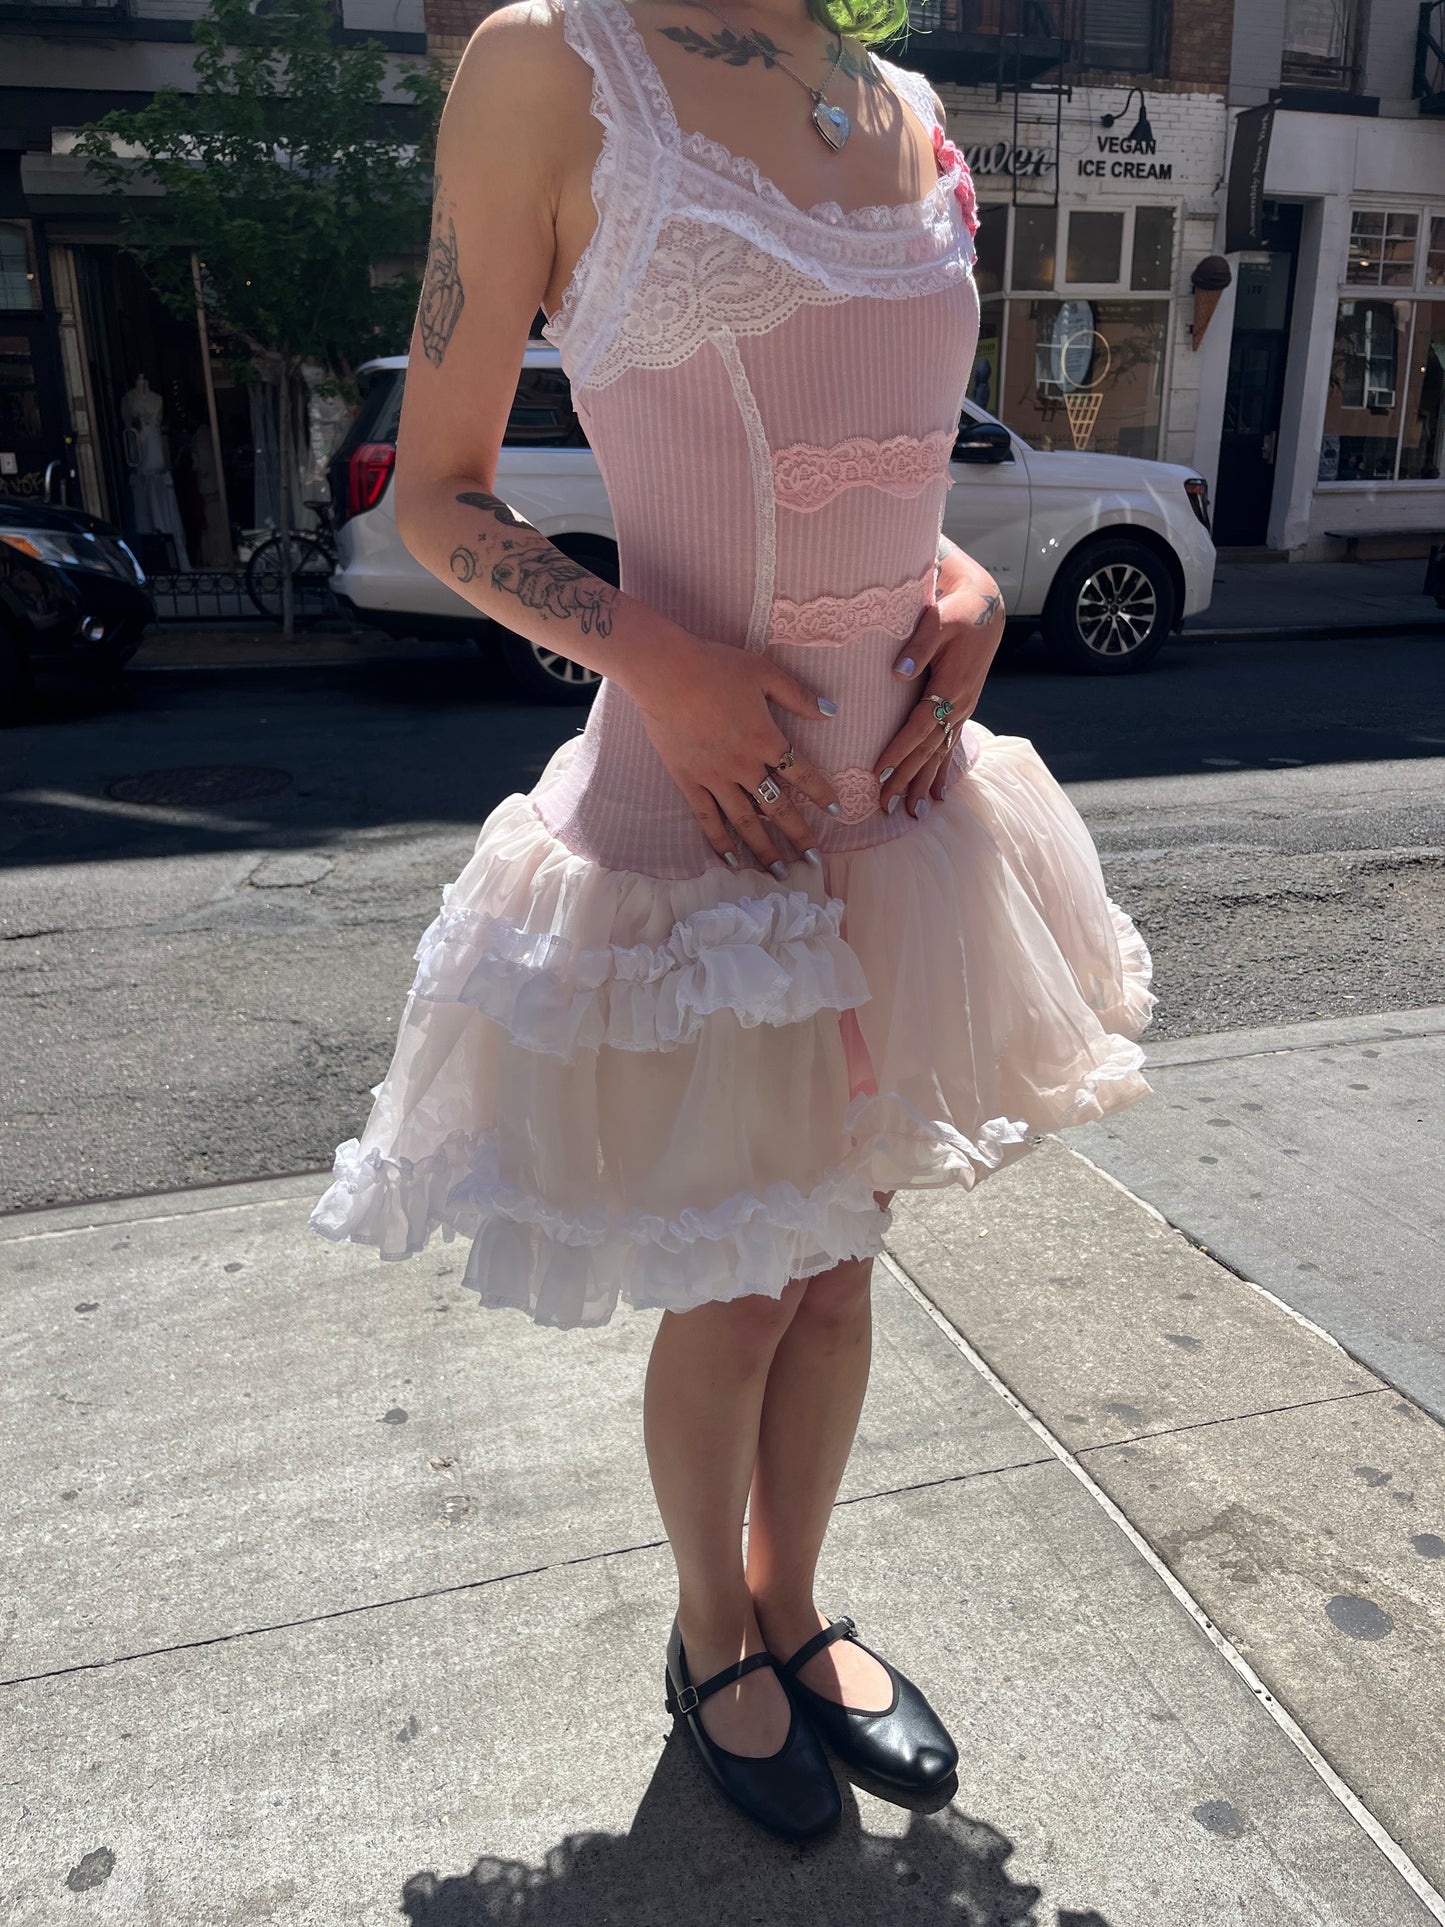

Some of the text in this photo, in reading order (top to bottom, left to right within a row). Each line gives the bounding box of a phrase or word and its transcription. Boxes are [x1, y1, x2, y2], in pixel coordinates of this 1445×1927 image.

[1097, 135, 1156, 155] VEGAN
[1078, 159, 1172, 180] ICE CREAM
[1249, 113, 1269, 236] Assembly New York
